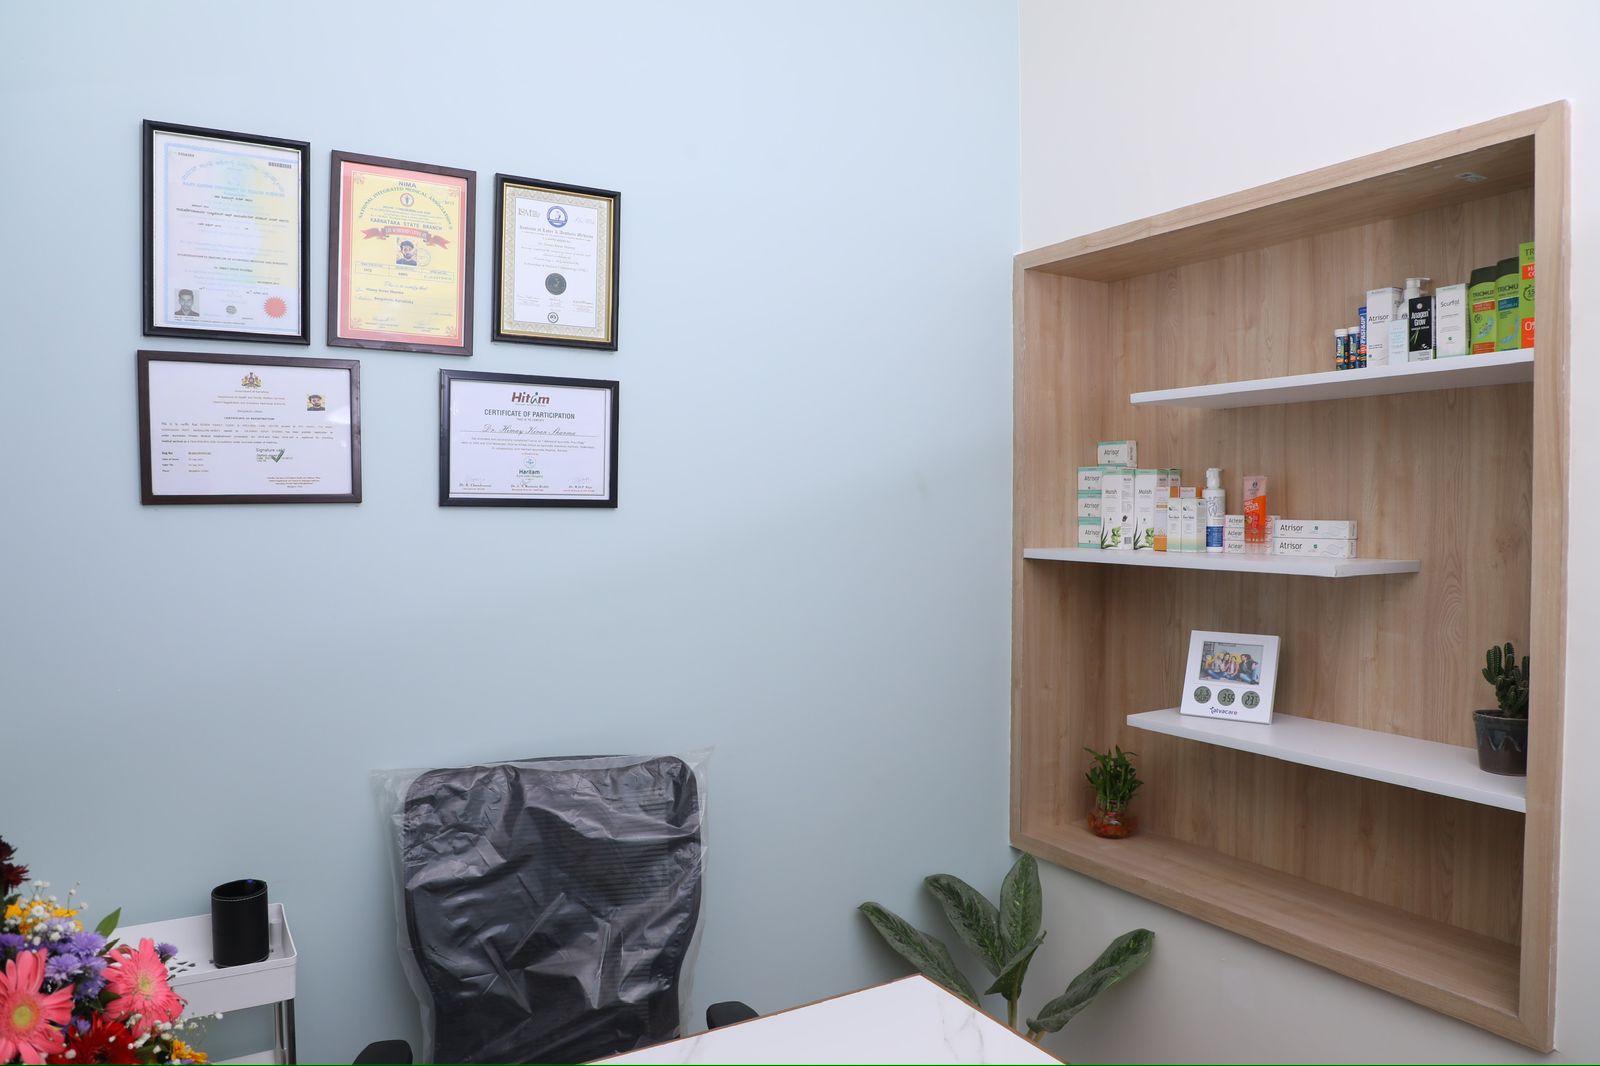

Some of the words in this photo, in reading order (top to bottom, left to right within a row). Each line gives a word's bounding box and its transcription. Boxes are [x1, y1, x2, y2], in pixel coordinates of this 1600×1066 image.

[370, 218, 400, 226] KARNATAKA
[1368, 314, 1389, 322] Atrisor
[1411, 310, 1428, 319] Anagen
[484, 408, 522, 418] CERTIFICATE
[532, 411, 576, 420] PARTICIPATION
[1280, 524, 1304, 532] Atrisor
[1280, 542, 1303, 550] Atrisor
